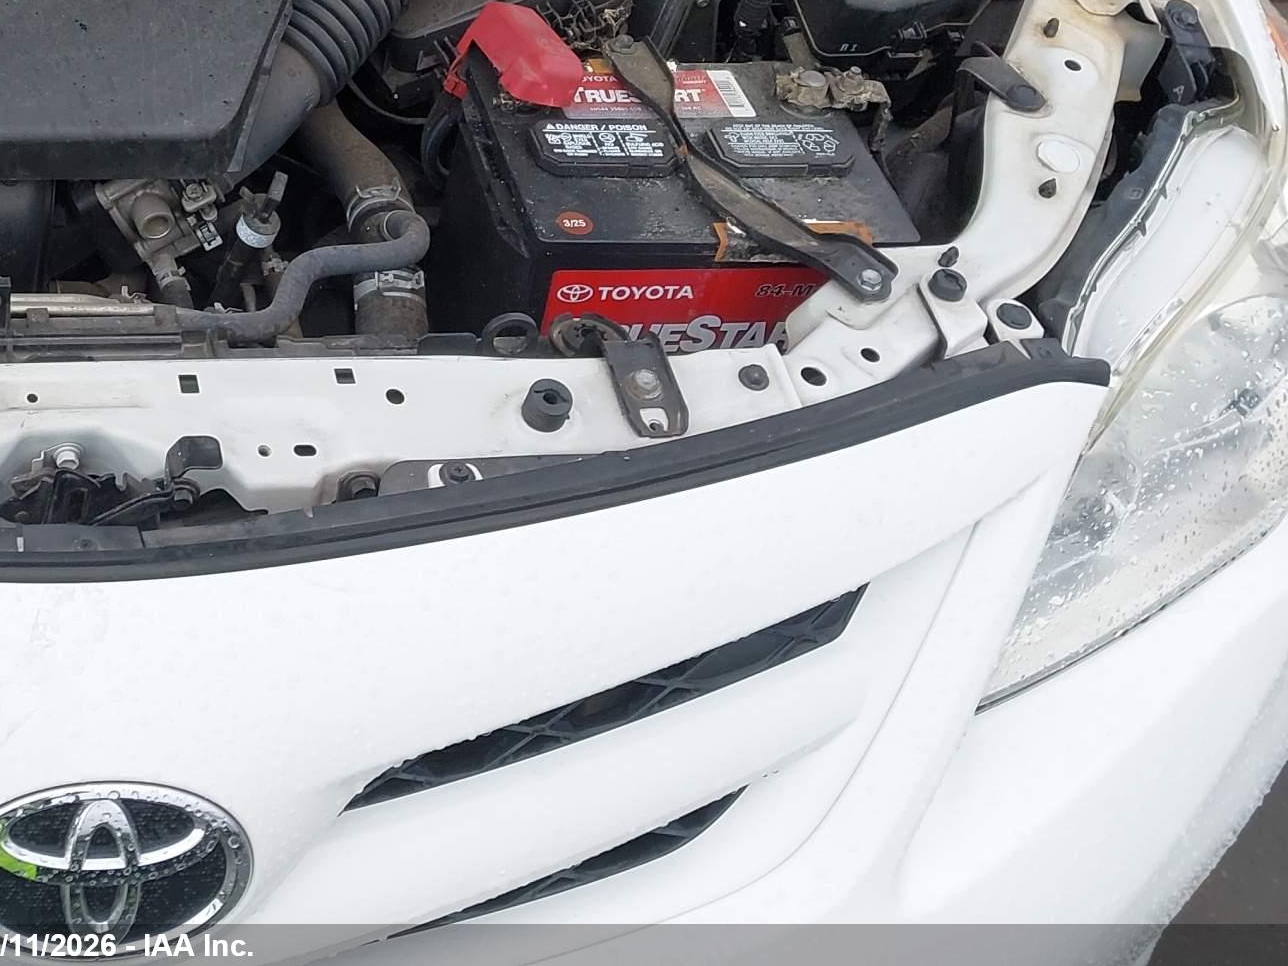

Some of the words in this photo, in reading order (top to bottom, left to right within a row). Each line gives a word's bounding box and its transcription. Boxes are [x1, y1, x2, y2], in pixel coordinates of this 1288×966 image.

[582, 75, 619, 83] YOTA
[562, 219, 587, 228] 3/25
[598, 285, 694, 301] TOYOTA
